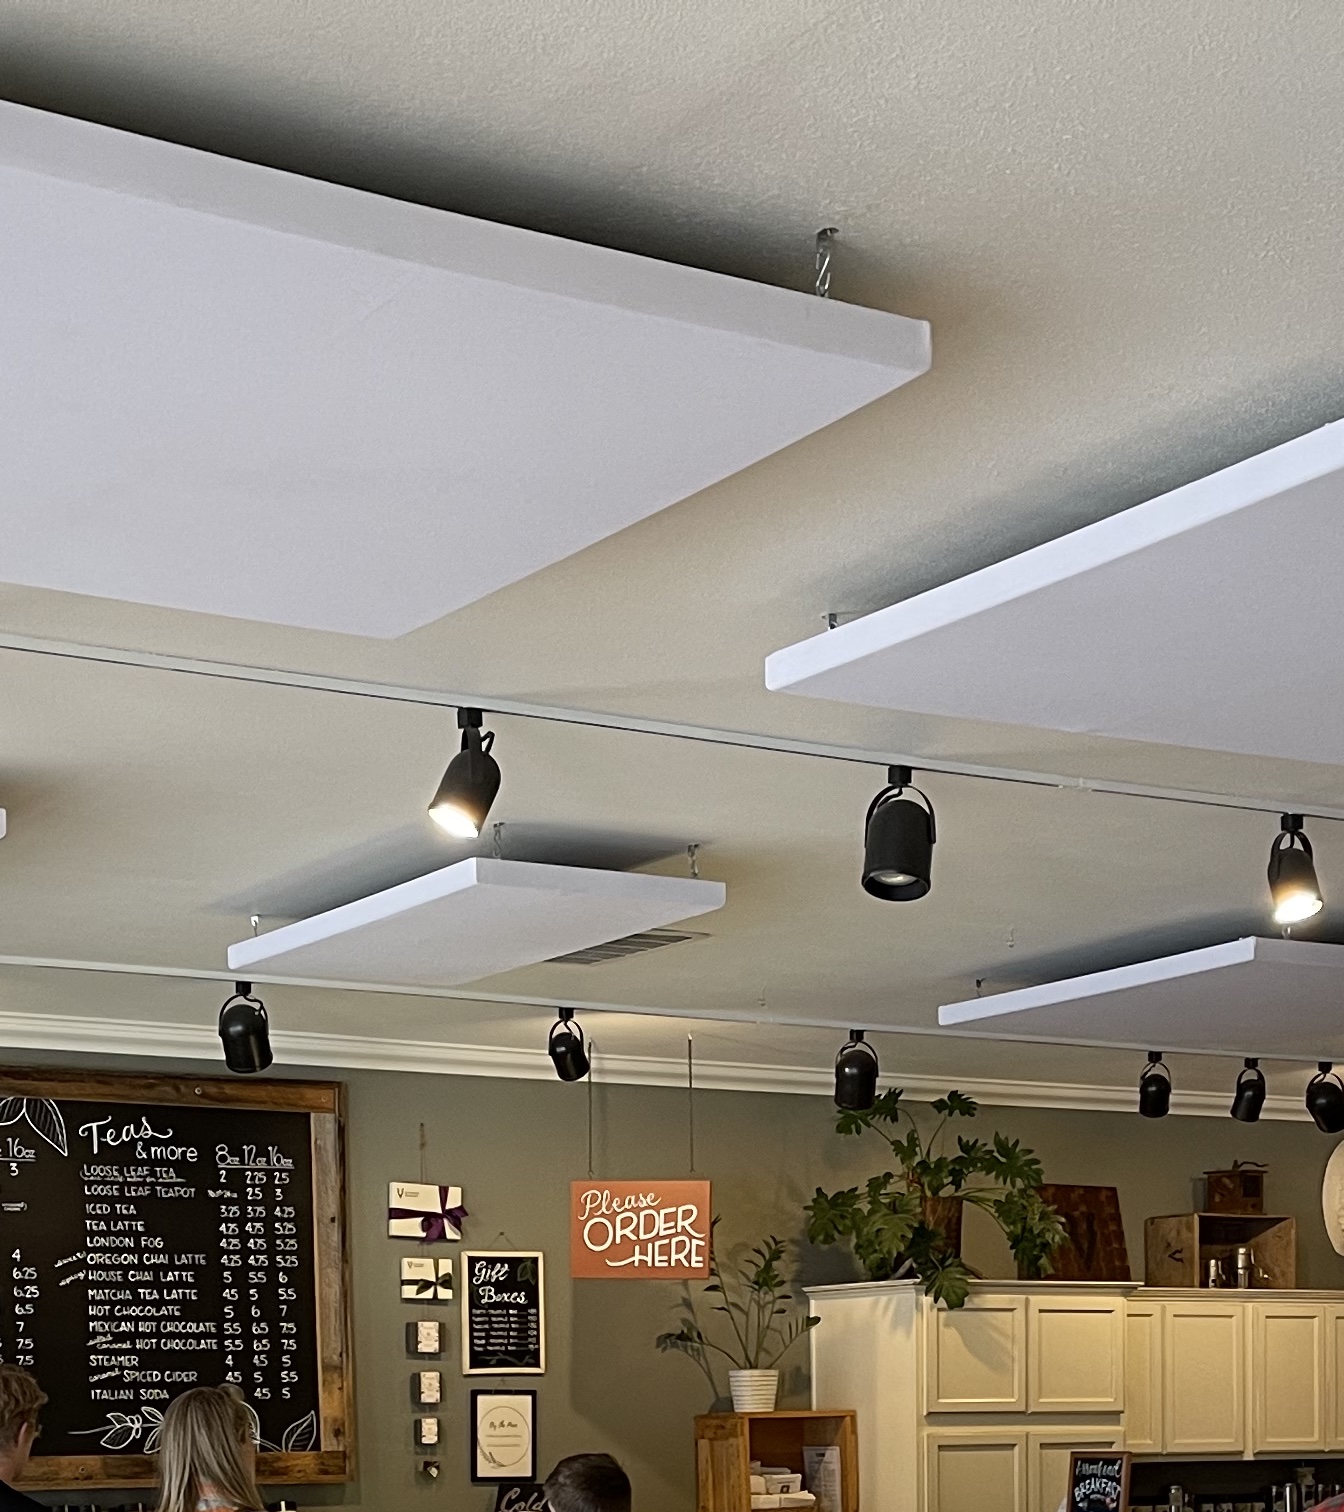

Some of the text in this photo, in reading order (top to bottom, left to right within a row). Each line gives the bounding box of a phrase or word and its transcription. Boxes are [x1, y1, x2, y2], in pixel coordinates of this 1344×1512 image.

[79, 1115, 173, 1154] Teas
[136, 1142, 147, 1158] &
[151, 1146, 197, 1161] more
[10, 1163, 18, 1176] 3
[83, 1164, 226, 1182] LOOSE LEAF TEA 2
[85, 1185, 119, 1195] LOOSE
[125, 1186, 150, 1196] LEAF
[155, 1187, 195, 1197] TEAPOT
[275, 1189, 282, 1200] 3
[86, 1204, 136, 1214] ICED TEA
[578, 1189, 661, 1220] Please
[86, 1220, 144, 1231] TEA LATTE
[583, 1204, 706, 1252] ORDER
[87, 1236, 163, 1248] LONDON FOG
[12, 1249, 20, 1261] 4
[605, 1235, 706, 1268] HERE
[87, 1253, 206, 1264] OREGON CHAI LATTE
[89, 1270, 122, 1281] HOUSE
[128, 1271, 153, 1281] CHAI
[160, 1272, 194, 1282] LATTE
[224, 1272, 232, 1283] 5
[279, 1272, 287, 1283] 6
[472, 1260, 510, 1285] Gift
[88, 1289, 132, 1300] MATCHA
[138, 1289, 159, 1299] TEA
[164, 1289, 197, 1299] LATTE
[250, 1289, 258, 1300] 5
[478, 1285, 529, 1305] Boxes
[89, 1305, 287, 1318] HOT CHOCOLATE 5 6 7
[16, 1322, 24, 1332] 7
[89, 1321, 134, 1332] MEXICAN
[139, 1322, 157, 1332] HOT
[161, 1322, 216, 1332] CHOCOLATE
[136, 1339, 157, 1349] HOT
[161, 1339, 217, 1350] CHOCOLATE
[89, 1355, 291, 1366] STEAMER 4 5
[123, 1370, 161, 1382] SPICED
[164, 1371, 197, 1382] CIDER
[254, 1372, 262, 1382] 5
[91, 1388, 290, 1400] ITALIAN SODA 5
[500, 1487, 549, 1512] Cold
